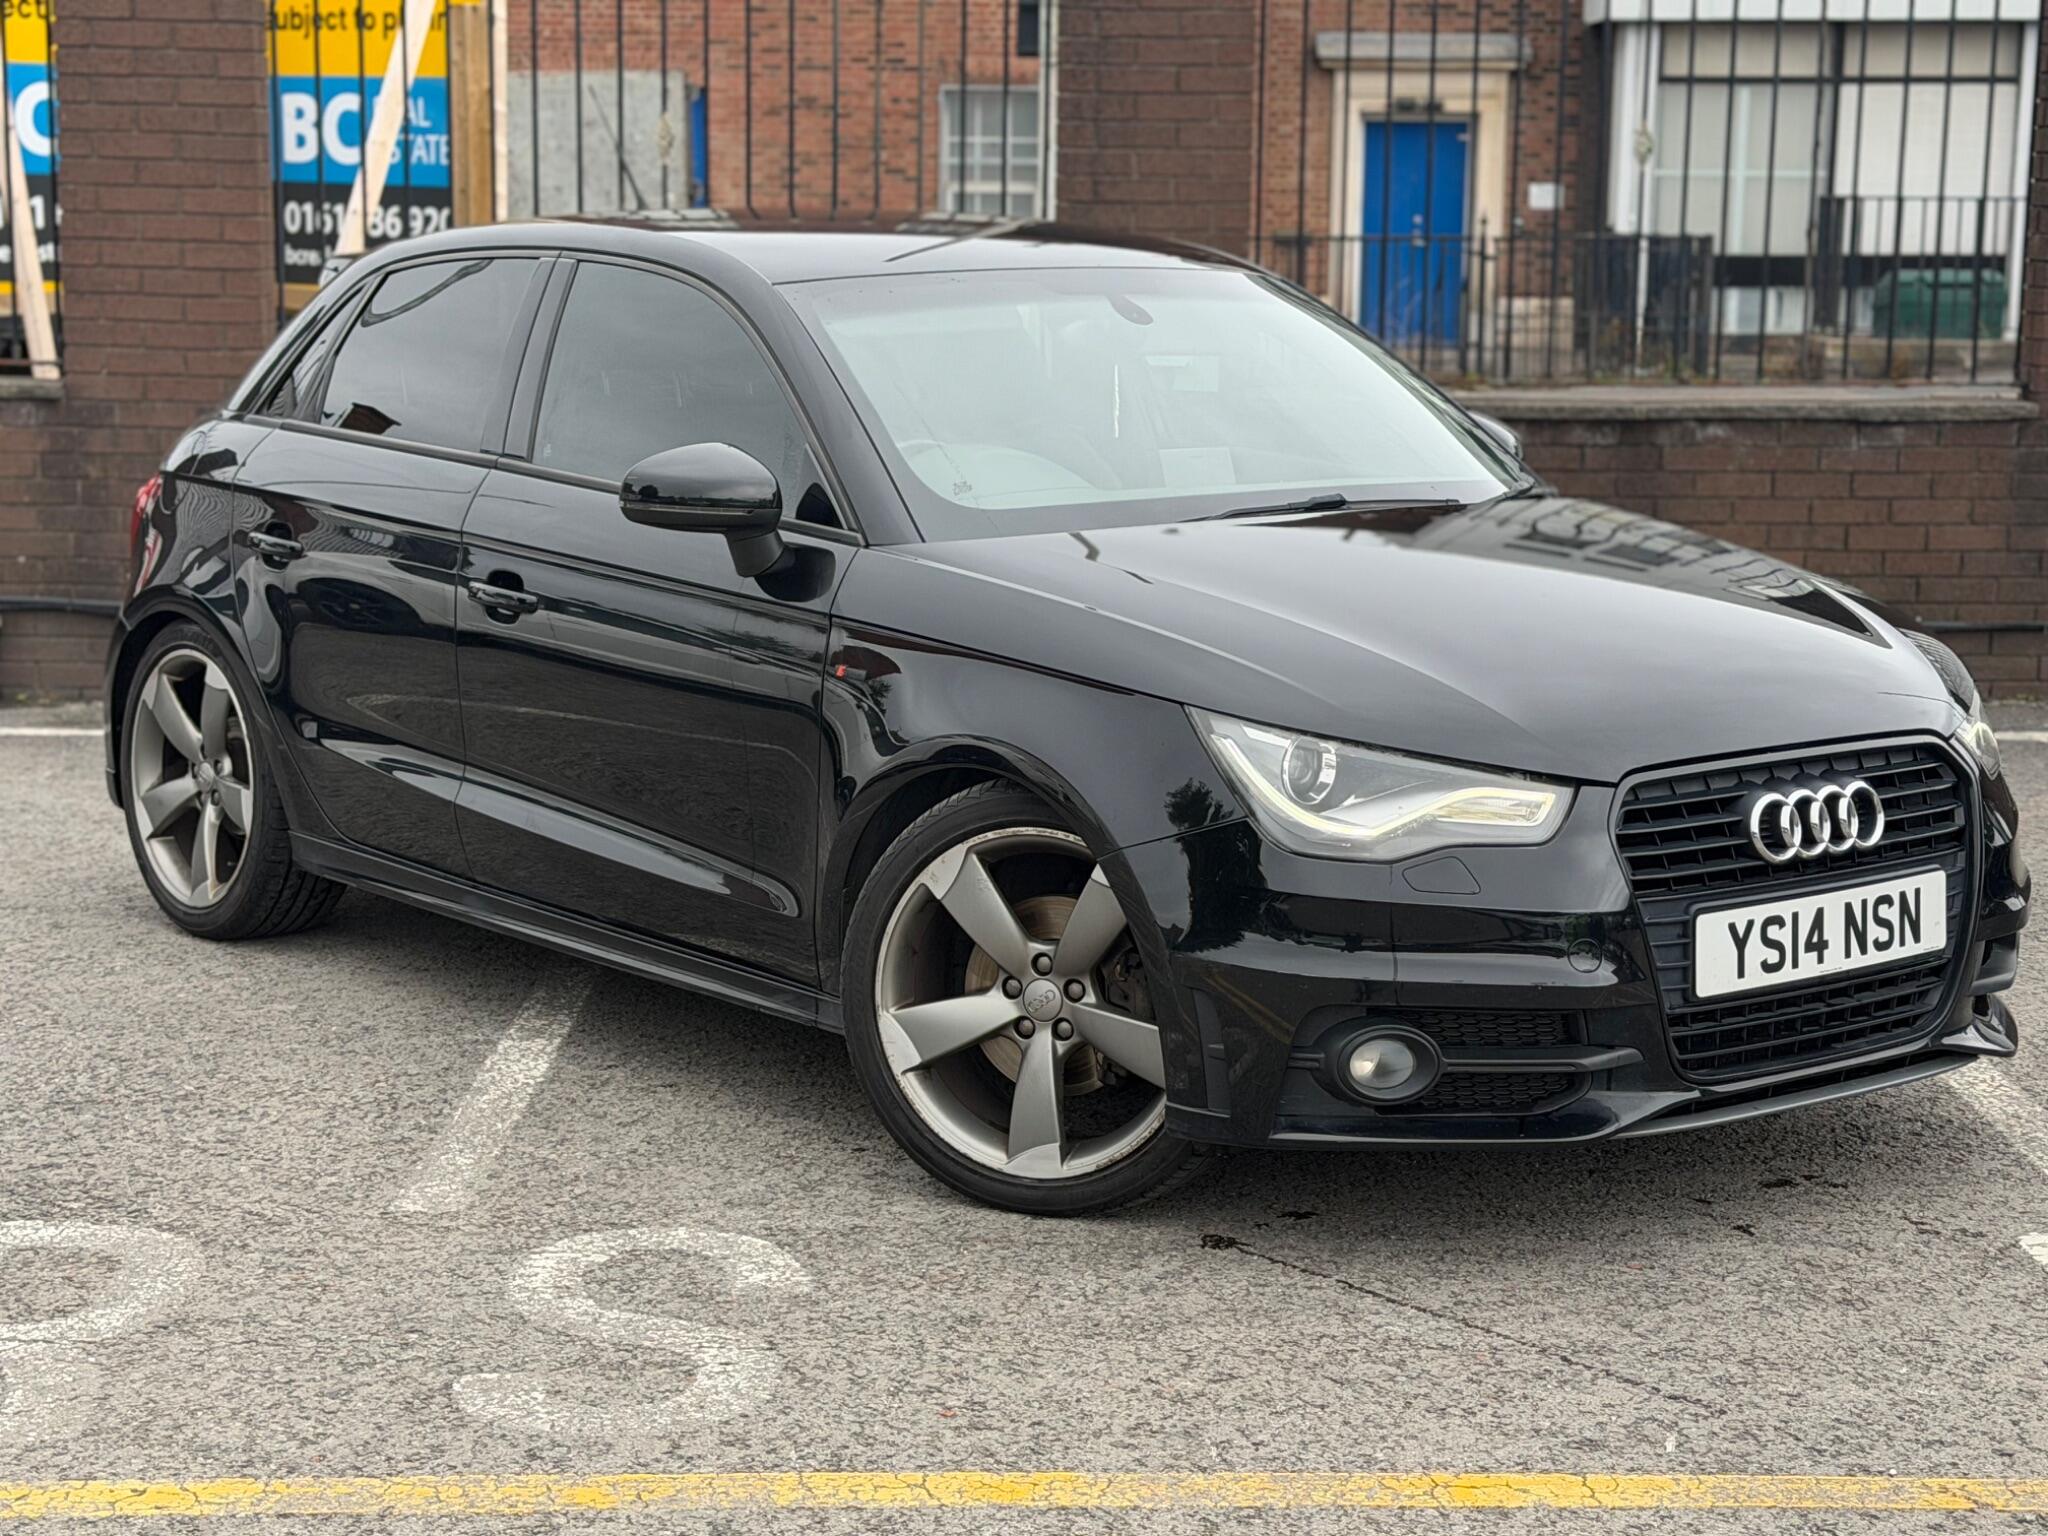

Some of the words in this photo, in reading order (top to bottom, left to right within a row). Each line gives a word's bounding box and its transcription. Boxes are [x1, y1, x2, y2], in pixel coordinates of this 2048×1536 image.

[282, 92, 361, 165] BC
[390, 133, 449, 166] STATE
[1728, 906, 1829, 980] YS14
[1844, 887, 1921, 960] NSN
